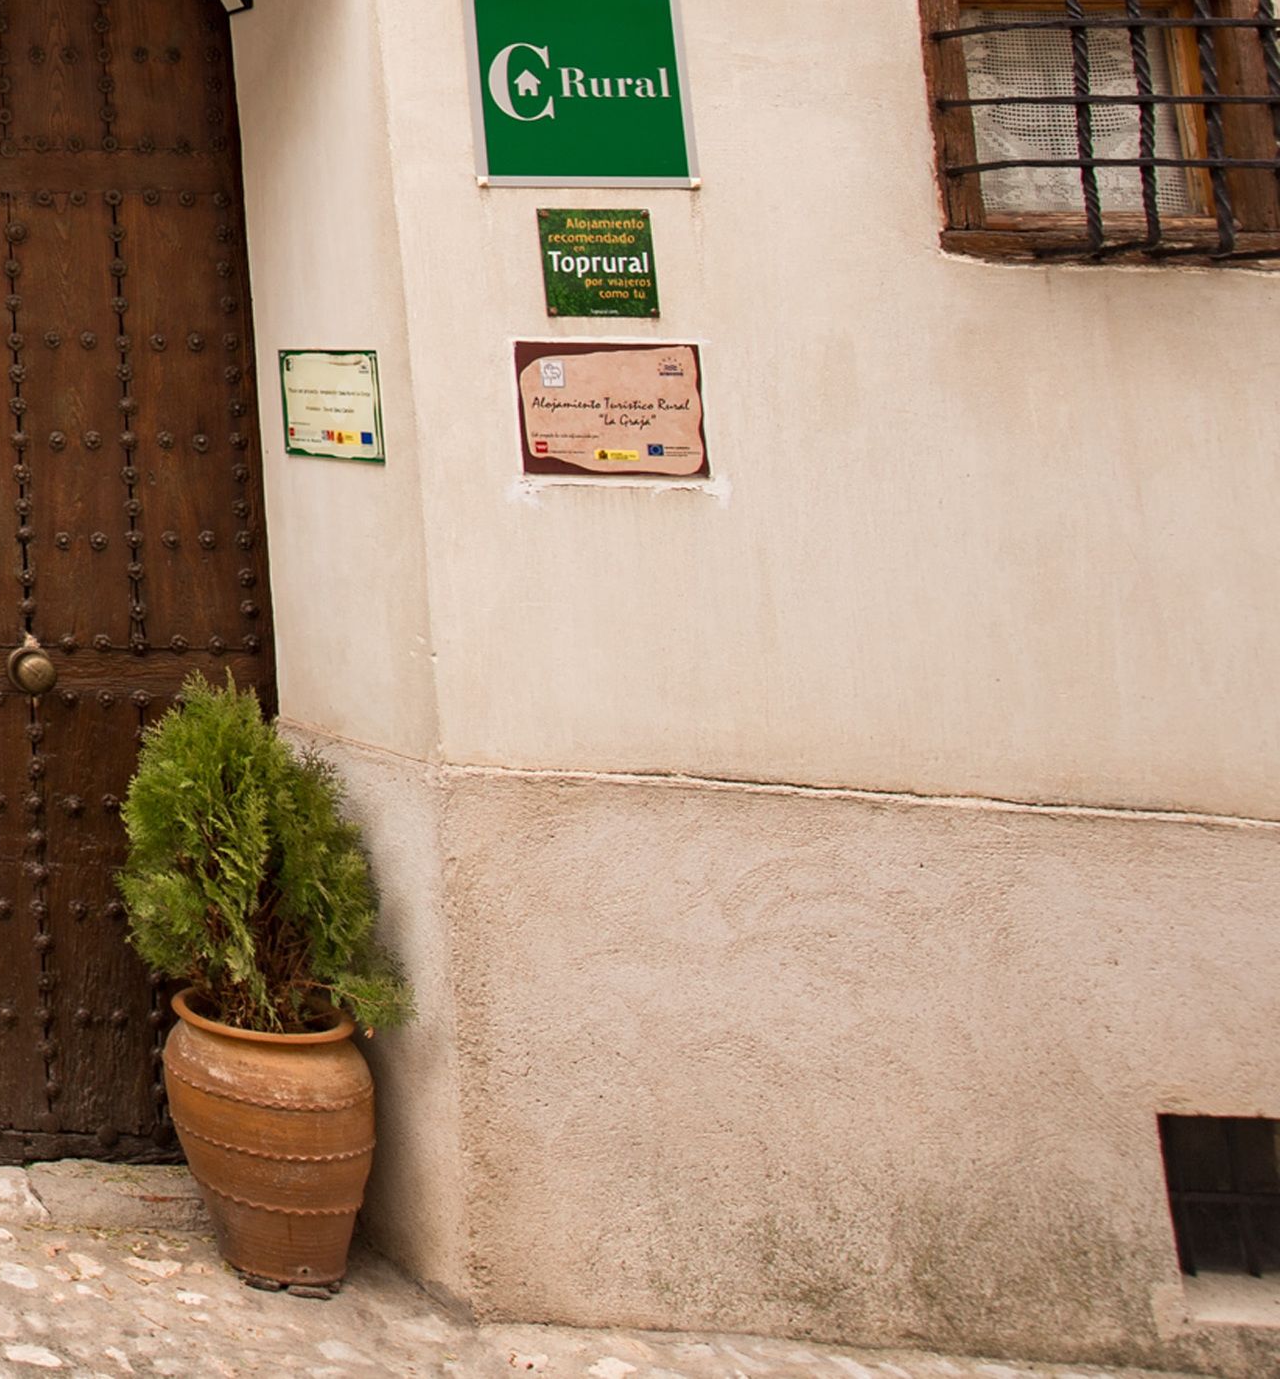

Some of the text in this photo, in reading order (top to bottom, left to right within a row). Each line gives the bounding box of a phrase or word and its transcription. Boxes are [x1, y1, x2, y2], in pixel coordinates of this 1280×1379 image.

[558, 67, 672, 98] Rural
[565, 218, 645, 231] Alojamiento
[548, 233, 636, 244] recomendado
[548, 251, 649, 278] Toprural
[584, 278, 652, 289] por viajeros
[599, 290, 630, 299] como
[531, 397, 601, 413] Alojamiento
[657, 398, 690, 411] Rural
